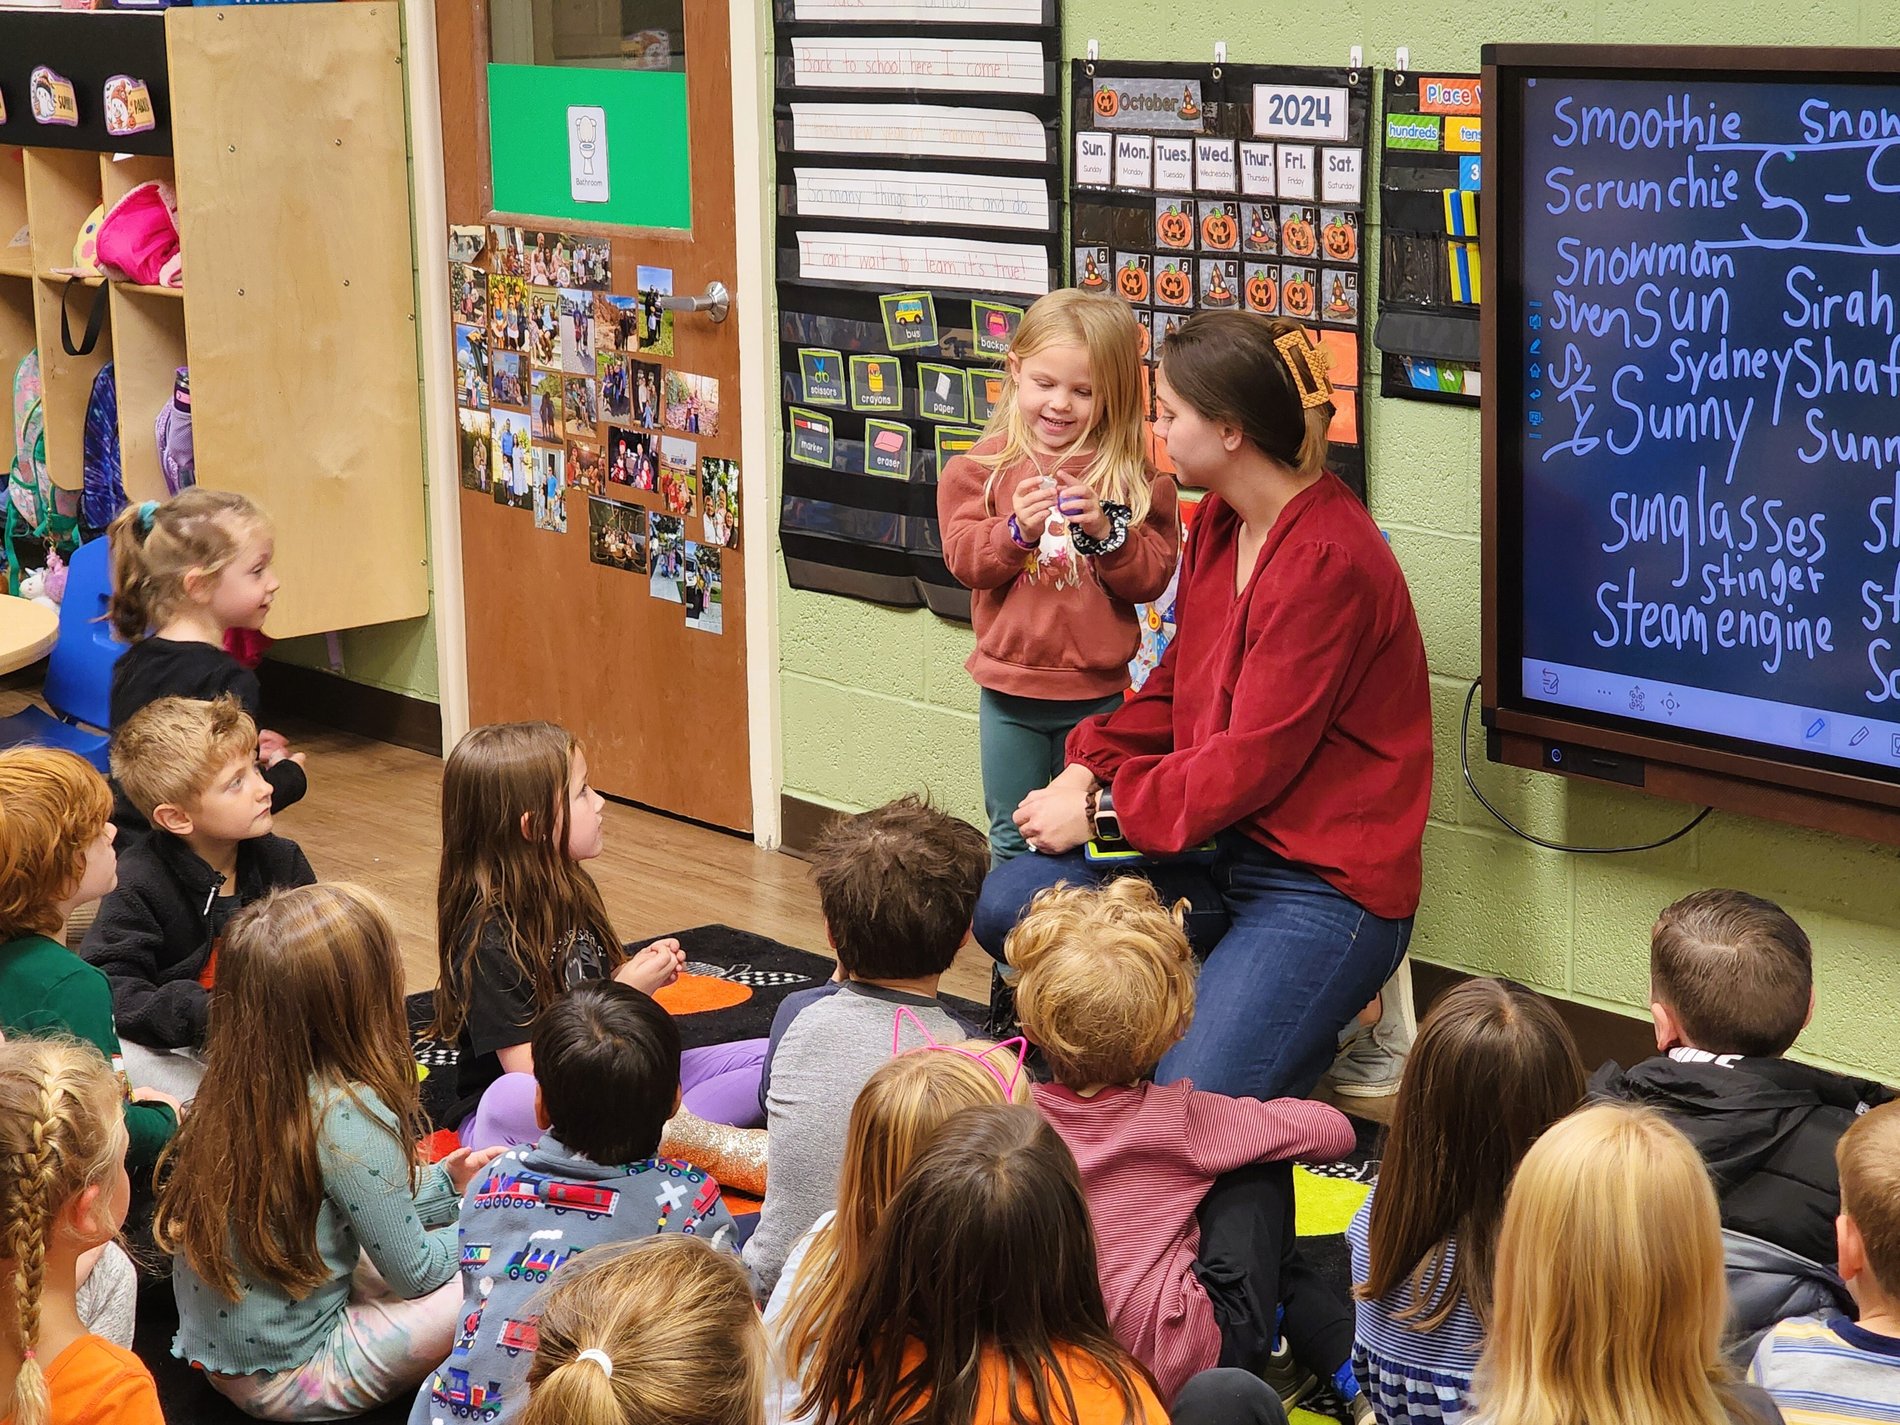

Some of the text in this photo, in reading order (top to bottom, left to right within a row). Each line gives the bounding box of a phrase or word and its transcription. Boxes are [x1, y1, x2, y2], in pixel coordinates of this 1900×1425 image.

[801, 48, 832, 73] Back
[843, 49, 857, 73] to
[909, 50, 933, 75] here
[941, 50, 954, 75] I
[1427, 84, 1471, 104] Place
[1119, 92, 1179, 112] October
[1268, 94, 1332, 127] 2024
[1552, 93, 1741, 150] Smoothie
[1389, 122, 1438, 139] hundreds
[1082, 140, 1106, 156] Sun.
[1119, 143, 1149, 160] Mon.
[1157, 146, 1191, 161] Tues.
[1199, 146, 1232, 163] Wed.
[1243, 149, 1272, 166] Thur.
[1285, 152, 1306, 169] Fri.
[1329, 155, 1354, 172] Sat.
[1083, 164, 1102, 175] Sunday
[1122, 167, 1143, 177] Monday
[1163, 170, 1185, 180] Tuesday
[1200, 168, 1232, 179] Wednesday
[1471, 164, 1479, 180] 3
[575, 177, 603, 187] Bathroom
[1247, 173, 1270, 183] Thursday
[1288, 176, 1305, 187] Friday
[1545, 155, 1739, 214] Scrunchie
[1328, 181, 1355, 191] Saturday
[807, 177, 823, 202] So
[830, 189, 861, 213] many
[873, 180, 907, 214] things
[913, 184, 928, 207] to
[939, 185, 974, 210] think
[983, 189, 1004, 213] and
[1226, 205, 1234, 216] 2
[1263, 208, 1270, 219] 3
[1305, 211, 1312, 222] 4
[1346, 215, 1353, 226] 5
[802, 241, 813, 266] I
[822, 243, 848, 268] can't
[860, 245, 887, 270] wait
[898, 247, 910, 272] to
[1099, 251, 1106, 262] 6
[1556, 236, 1735, 286] Snowman
[1140, 258, 1147, 270] 7
[1181, 261, 1189, 273] 8
[1228, 264, 1235, 276] 9
[1269, 268, 1277, 280] 10
[1307, 272, 1314, 283] 11
[1347, 276, 1355, 288] 12
[1783, 265, 1894, 335] Sirah
[1141, 313, 1150, 326] 14
[1633, 282, 1730, 349] Sun
[905, 327, 921, 339] bus
[1666, 337, 1794, 426] Sydney
[810, 384, 837, 397] scissors
[861, 393, 891, 406] crayons
[933, 402, 955, 416] paper
[1606, 364, 1754, 485] Sunny
[801, 438, 824, 454] marker
[876, 455, 900, 469] eraser
